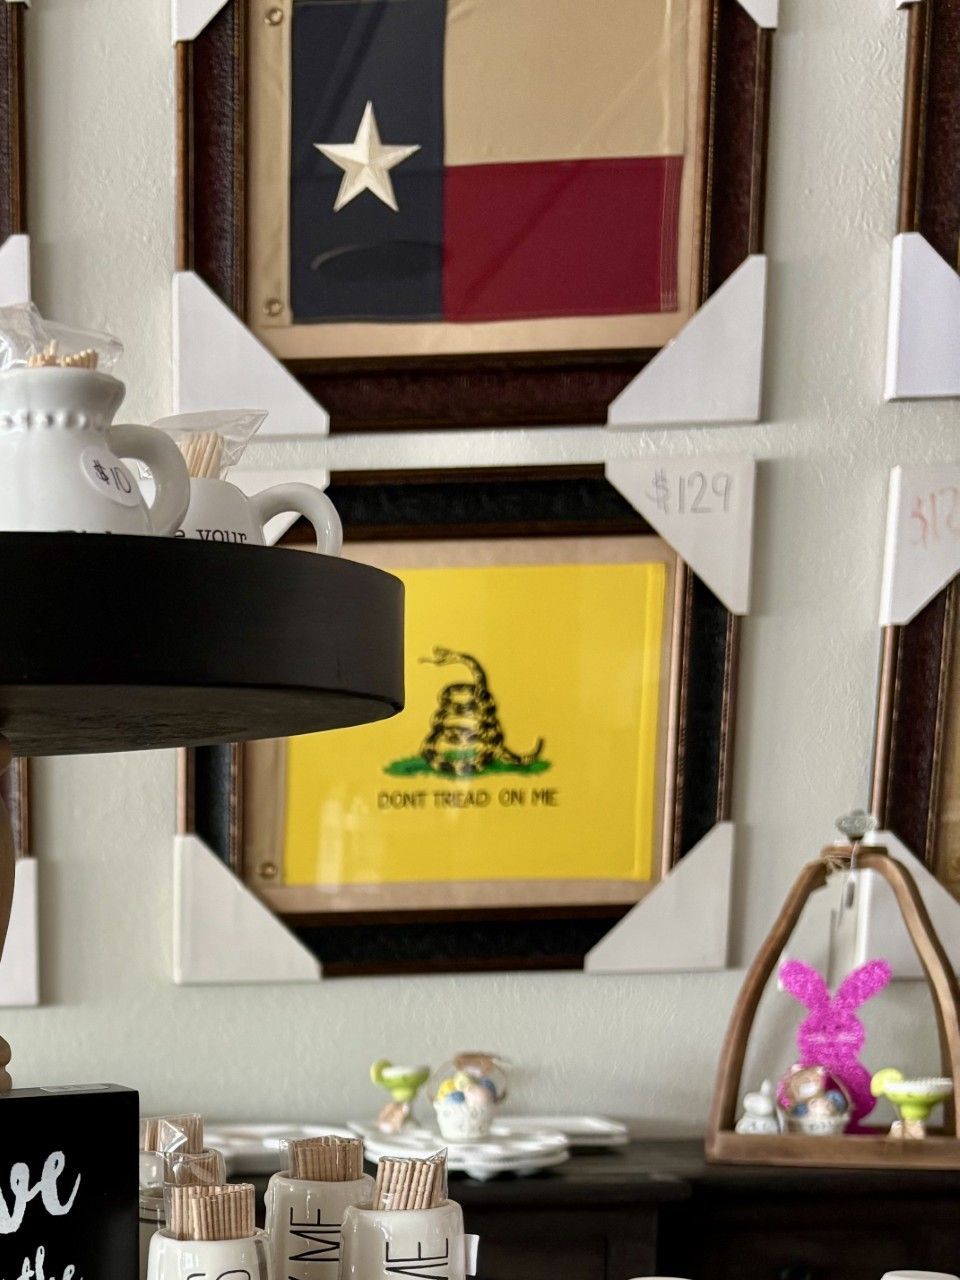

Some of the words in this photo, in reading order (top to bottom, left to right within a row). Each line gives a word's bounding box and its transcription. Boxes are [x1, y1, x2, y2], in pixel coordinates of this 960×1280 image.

[92, 459, 133, 495] $10
[644, 467, 733, 515] $129
[910, 486, 960, 549] $12
[377, 790, 427, 809] DONT
[433, 789, 489, 808] TREAD
[498, 787, 525, 807] ON
[531, 786, 559, 807] ME
